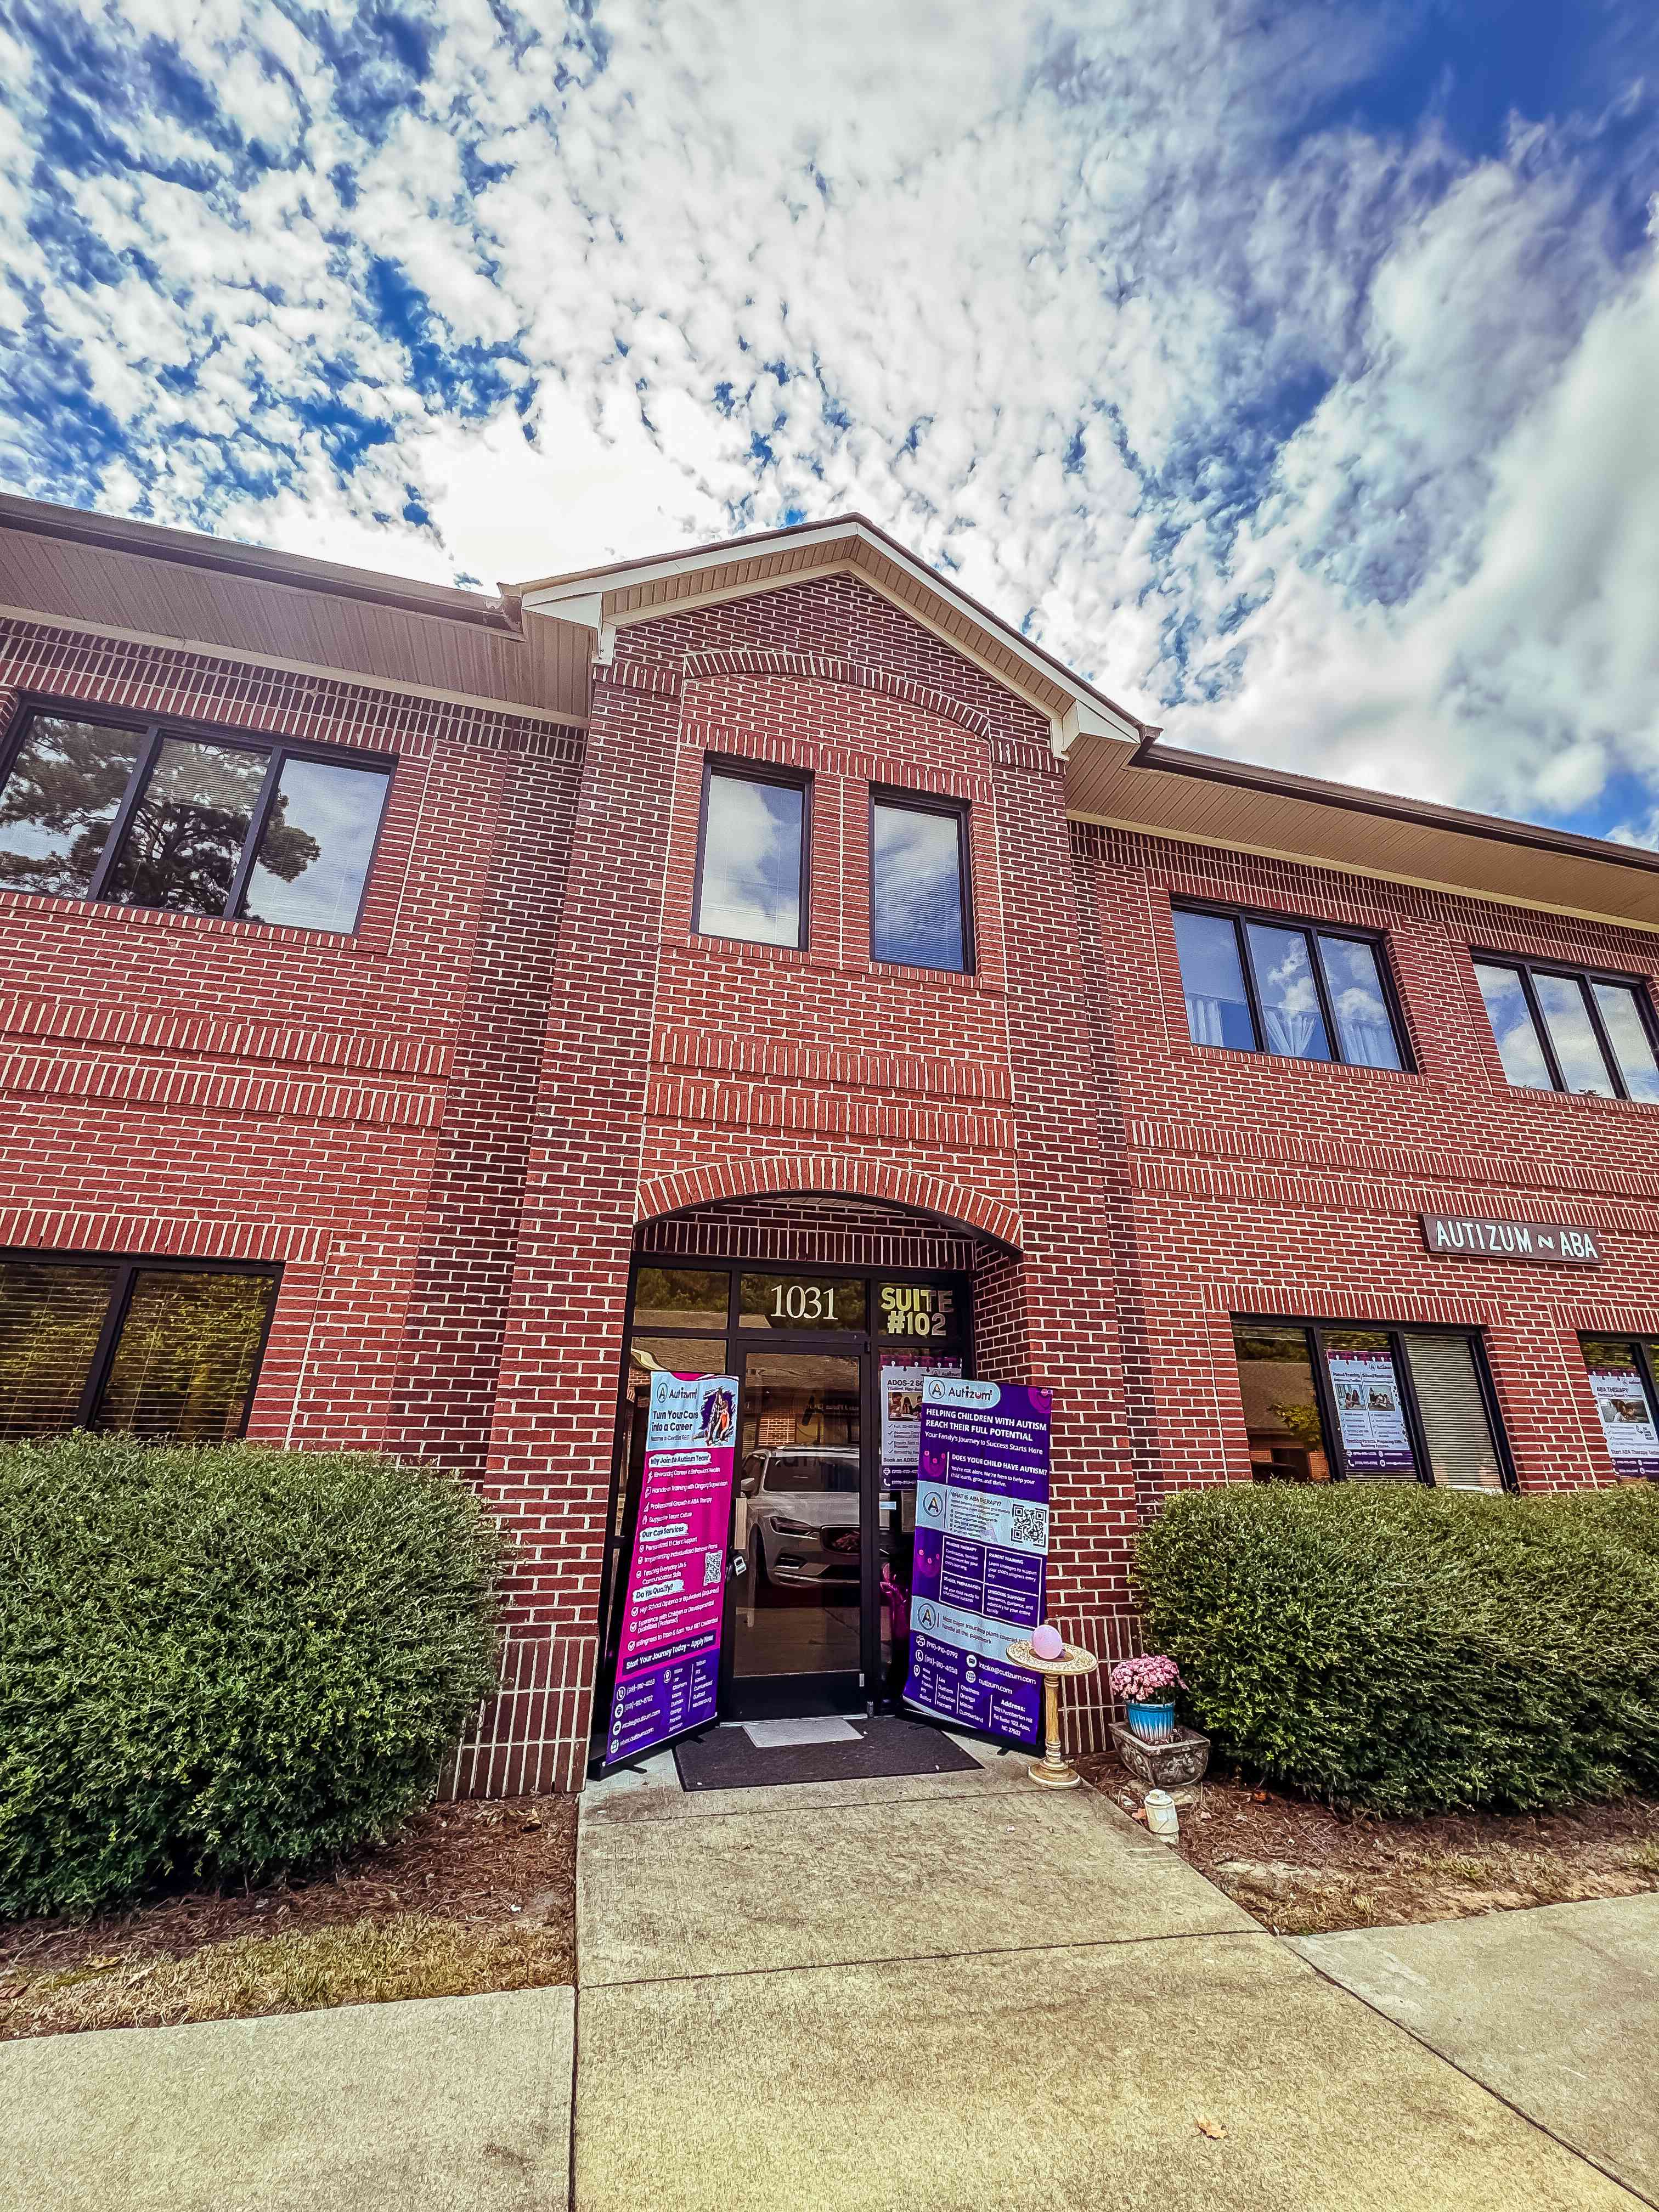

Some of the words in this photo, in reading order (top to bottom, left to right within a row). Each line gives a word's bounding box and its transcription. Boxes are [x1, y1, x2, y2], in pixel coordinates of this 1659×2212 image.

[1436, 1220, 1533, 1254] AUTIZUM
[1560, 1231, 1599, 1259] ABA
[770, 1285, 838, 1320] 1031
[881, 1287, 953, 1313] SUITE
[887, 1311, 946, 1336] #102
[653, 1410, 666, 1419] Turn
[668, 1410, 683, 1419] Your
[927, 1408, 956, 1418] HELPING
[957, 1412, 993, 1424] CHILDREN
[995, 1417, 1015, 1426] WITH
[1016, 1420, 1047, 1431] AUTISM
[652, 1422, 662, 1431] into
[670, 1423, 692, 1431] Career
[926, 1420, 949, 1428] REACH
[950, 1422, 969, 1432] THEIR
[972, 1425, 988, 1435] FULL
[990, 1428, 1033, 1441] POTENTIAL
[939, 1433, 958, 1442] Family's
[958, 1436, 979, 1446] Journey
[986, 1441, 1009, 1449] Success
[1009, 1444, 1027, 1453] Starts
[952, 1454, 966, 1462] DOES
[984, 1459, 1002, 1468] CHILD
[1003, 1463, 1019, 1471] HAVE
[1019, 1465, 1047, 1476] AUTISM?
[663, 1526, 684, 1534] Services
[627, 1658, 639, 1669] Start
[640, 1655, 652, 1664] Your
[652, 1649, 672, 1661] Journey
[672, 1643, 687, 1654] Today
[691, 1638, 704, 1648] Apply
[1001, 1700, 1026, 1712] Address:
